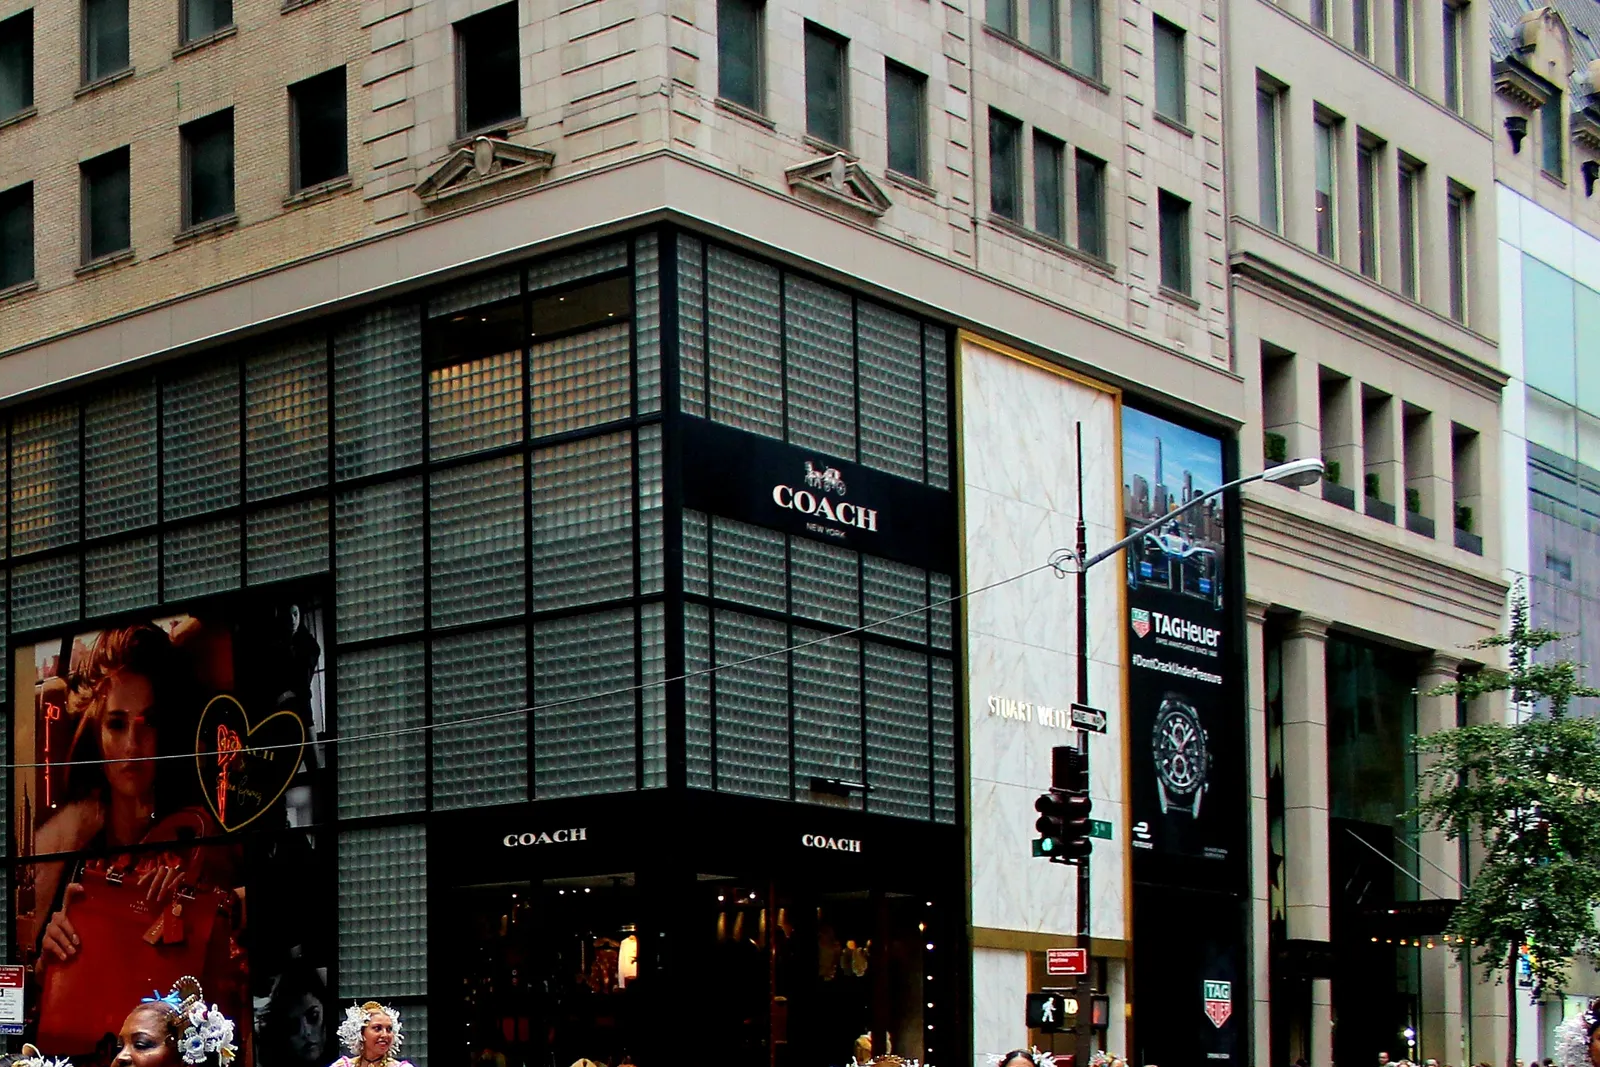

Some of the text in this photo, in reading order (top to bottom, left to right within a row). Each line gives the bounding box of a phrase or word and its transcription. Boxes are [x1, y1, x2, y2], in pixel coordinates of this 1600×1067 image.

[772, 484, 878, 532] COACH
[806, 522, 846, 538] NEW YORK
[988, 695, 1088, 733] STUART WEITZ
[503, 827, 587, 847] COACH
[801, 833, 862, 853] COACH
[1207, 983, 1229, 999] TAG
